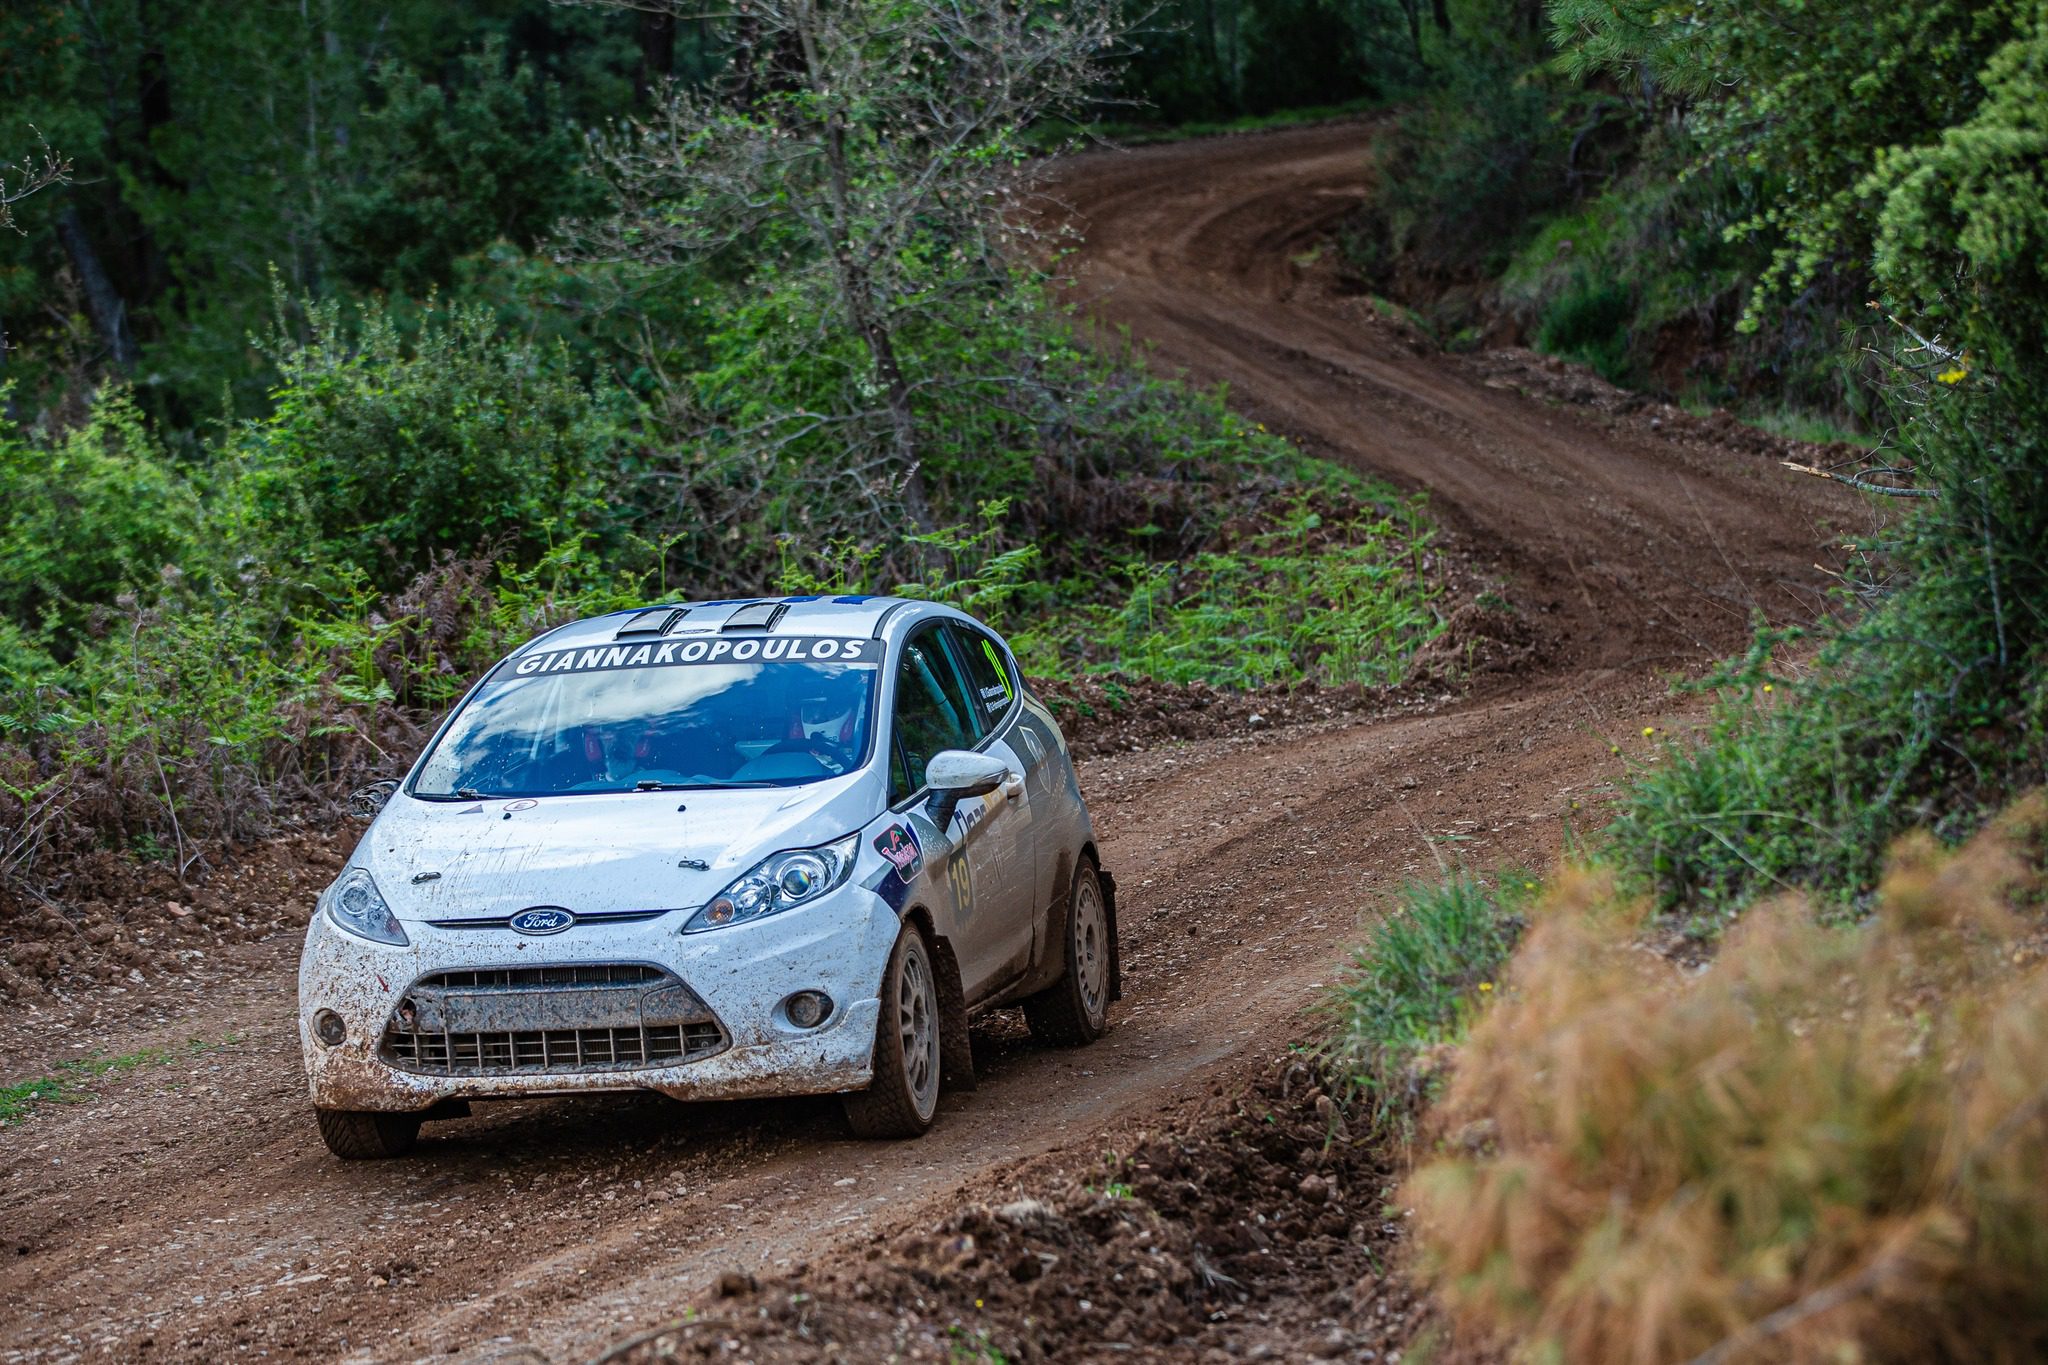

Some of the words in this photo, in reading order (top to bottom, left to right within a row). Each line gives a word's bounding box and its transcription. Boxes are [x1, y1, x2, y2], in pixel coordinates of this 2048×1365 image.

[515, 638, 866, 676] GIANNAKOPOULOS
[980, 639, 1014, 701] 19
[951, 857, 971, 911] 19
[523, 912, 558, 928] Ford
